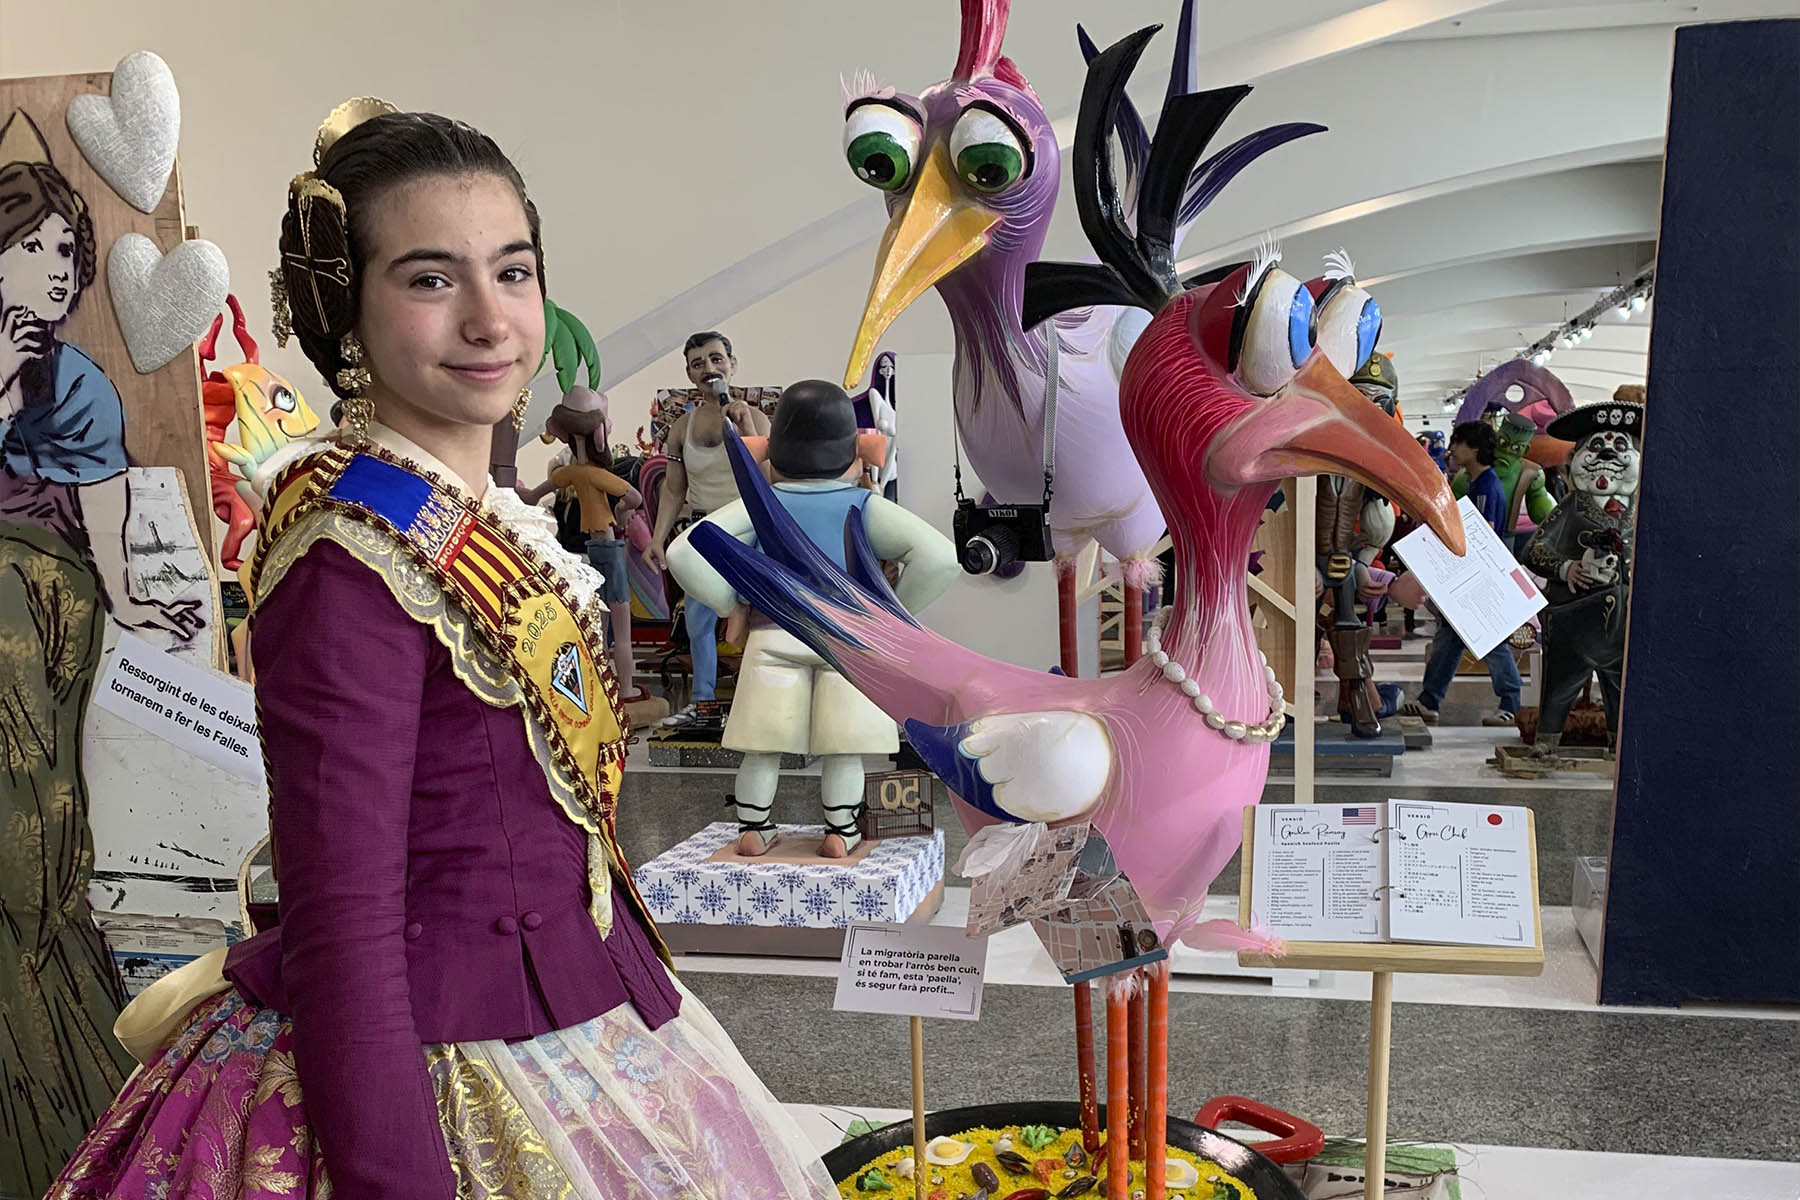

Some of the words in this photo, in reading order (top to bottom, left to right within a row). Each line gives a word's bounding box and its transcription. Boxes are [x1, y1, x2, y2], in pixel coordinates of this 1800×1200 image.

[521, 601, 557, 657] 2025
[118, 657, 182, 699] Ressorgint
[182, 691, 198, 706] de
[199, 698, 217, 716] les
[110, 678, 163, 714] tornarem
[164, 708, 173, 719] a
[174, 711, 193, 728] fer
[193, 720, 212, 738] les
[212, 730, 249, 758] Falles.
[860, 947, 872, 956] La
[874, 948, 925, 960] migratòria
[927, 951, 960, 962] parella
[859, 959, 871, 967] en
[873, 958, 903, 969] trobar
[905, 961, 936, 971] l'arròs
[937, 963, 956, 973] ben
[958, 965, 980, 976] cuit,
[857, 969, 866, 977] si
[867, 969, 877, 978] té
[879, 970, 901, 981] fam,
[903, 972, 924, 982] esta
[926, 974, 962, 985] 'paella',
[855, 979, 866, 988] és
[868, 981, 896, 992] segur
[898, 981, 918, 992] farà
[919, 984, 955, 995] profit...
